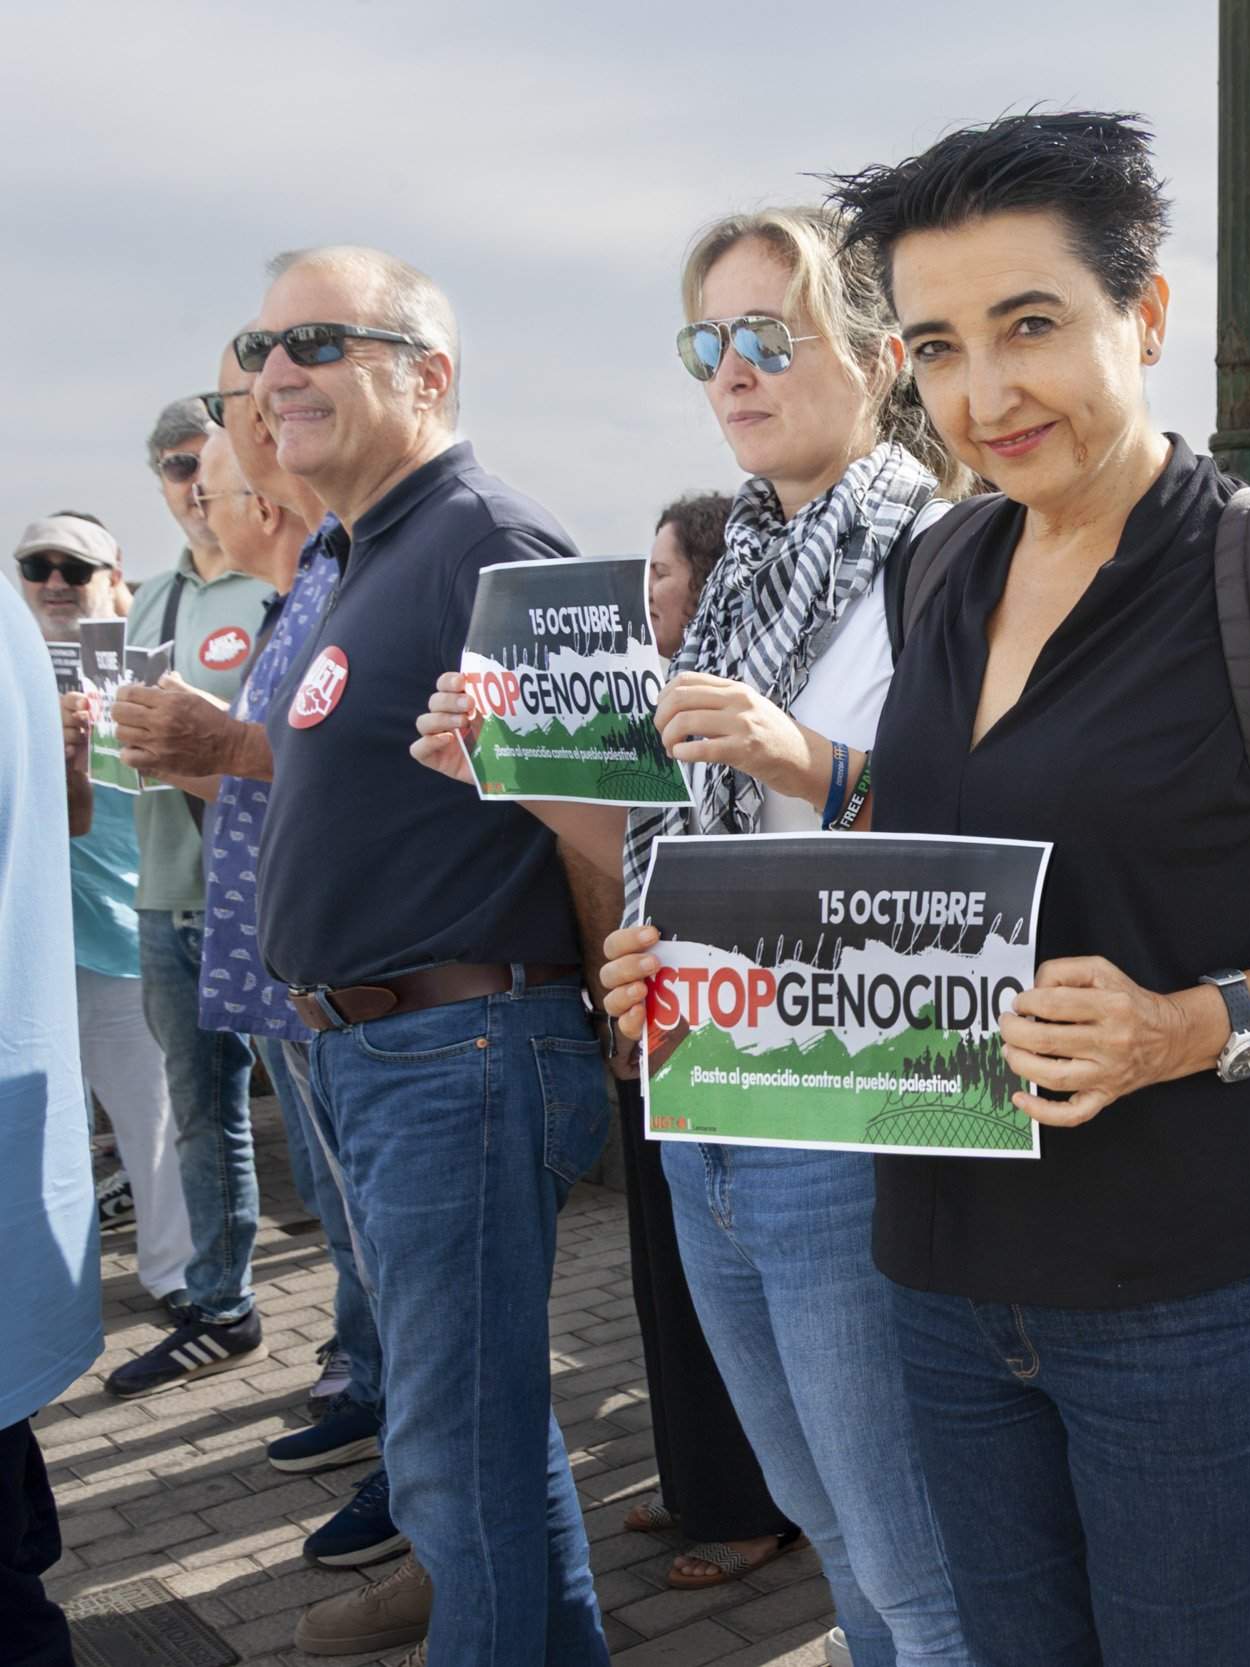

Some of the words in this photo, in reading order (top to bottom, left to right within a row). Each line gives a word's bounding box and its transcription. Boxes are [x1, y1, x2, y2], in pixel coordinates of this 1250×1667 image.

[528, 608, 544, 635] 15
[546, 604, 623, 634] OCTUBRE
[463, 670, 662, 717] TOPGENOCIDIO
[840, 793, 865, 828] FREE
[818, 890, 844, 925] 15
[850, 889, 987, 926] OCTUBRE
[690, 1065, 727, 1086] ¡Basta
[728, 1067, 740, 1085] al
[741, 1069, 800, 1090] genocidio
[801, 1071, 841, 1089] contra
[843, 1071, 854, 1089] el
[855, 1072, 896, 1093] pueblo
[899, 1074, 961, 1094] palestino!
